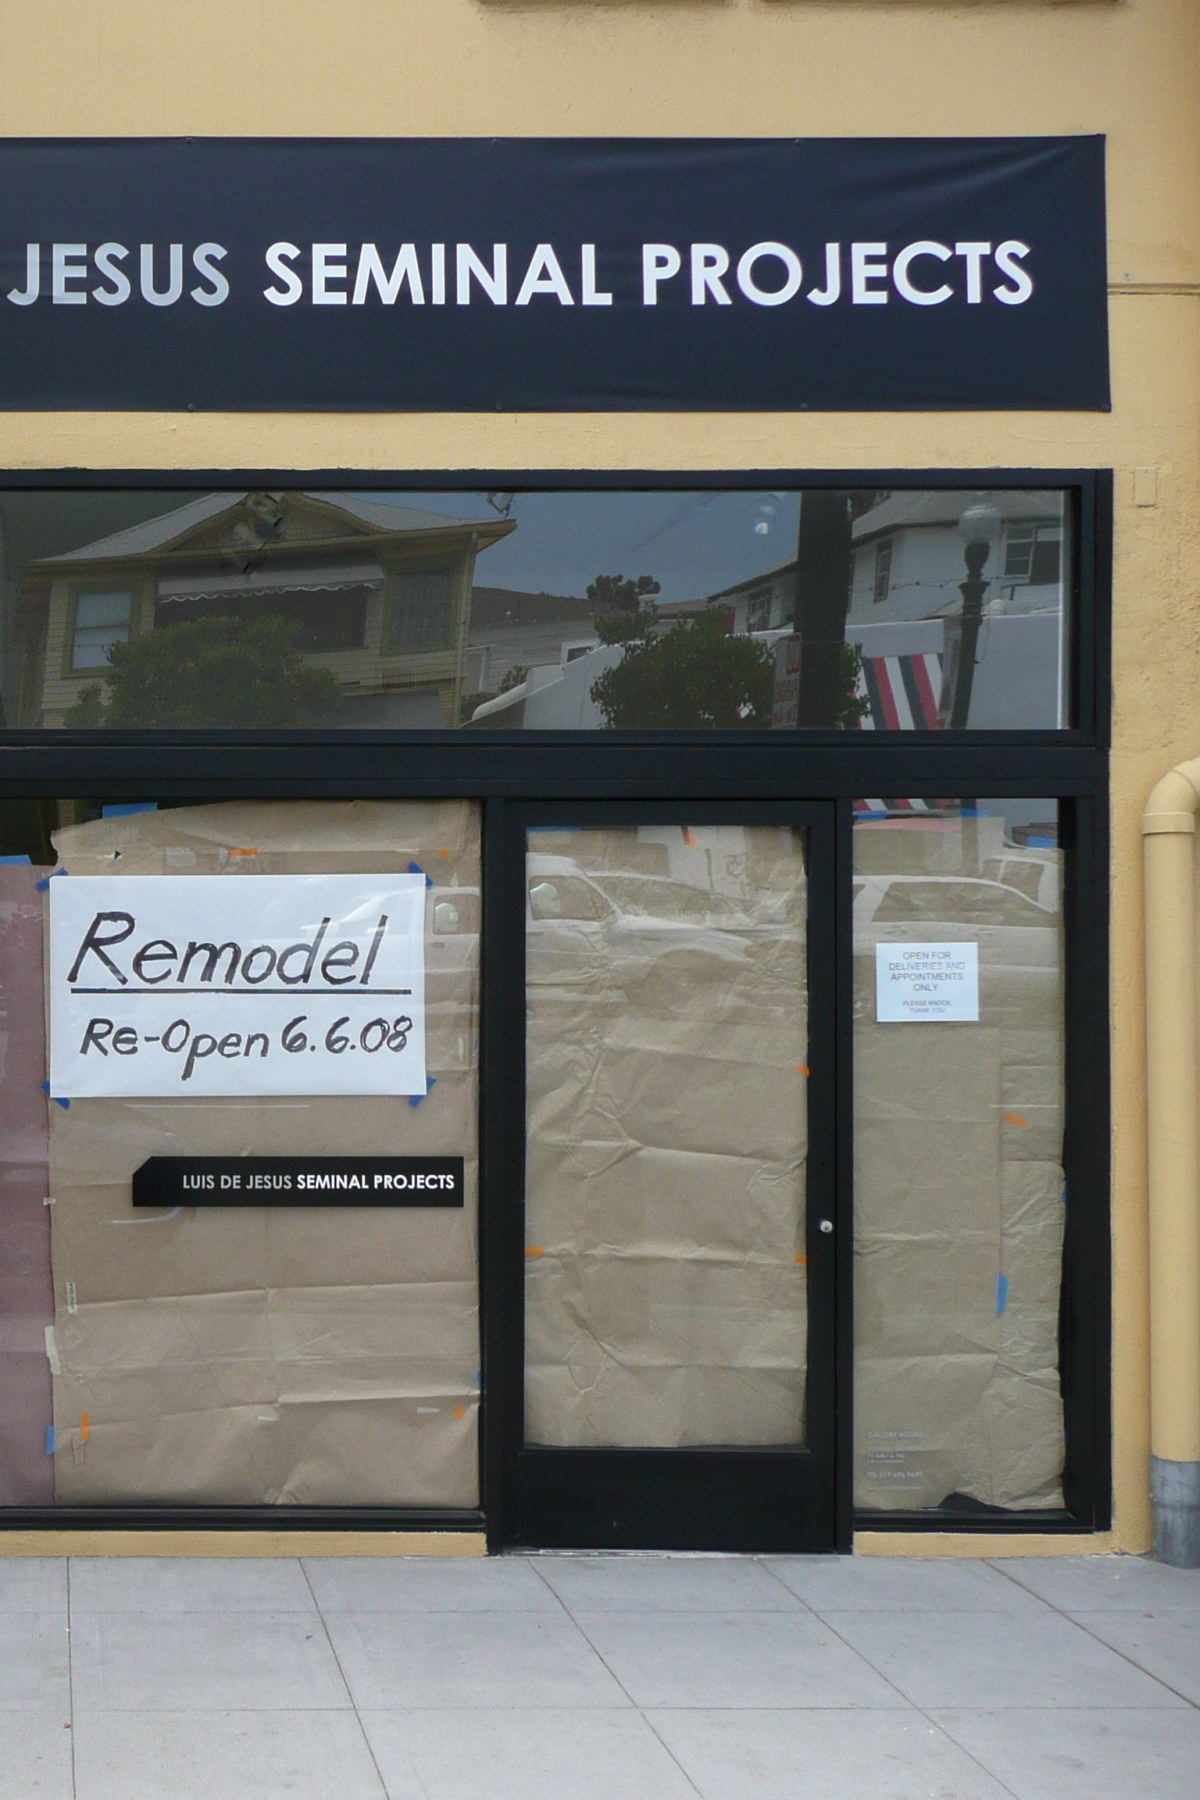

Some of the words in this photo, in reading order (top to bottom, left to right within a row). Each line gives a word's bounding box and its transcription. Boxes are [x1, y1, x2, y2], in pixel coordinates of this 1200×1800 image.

[6, 241, 230, 307] JESUS
[262, 241, 613, 307] SEMINAL
[642, 241, 1034, 307] PROJECTS
[66, 911, 389, 986] Remodel
[902, 951, 929, 960] OPEN
[931, 951, 952, 960] FOR
[888, 962, 944, 971] DELIVERIES
[945, 961, 966, 970] AND
[890, 972, 965, 981] APPOINTMENTS
[79, 1017, 270, 1081] Re-Open
[281, 1015, 413, 1055] 6.6.08
[182, 1174, 215, 1190] LUIS
[220, 1174, 242, 1190] DE
[245, 1174, 293, 1190] JESUS
[296, 1173, 370, 1190] SEMINAL
[373, 1173, 455, 1190] PROJECTS
